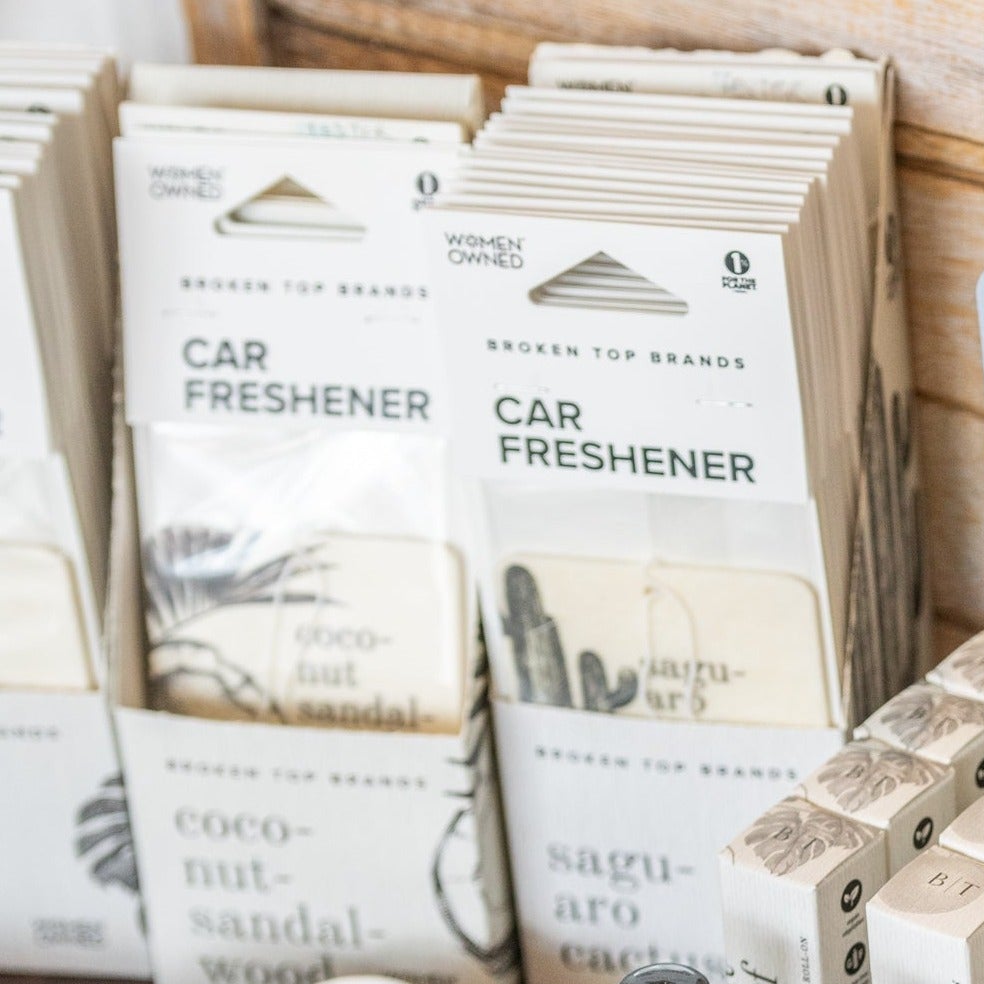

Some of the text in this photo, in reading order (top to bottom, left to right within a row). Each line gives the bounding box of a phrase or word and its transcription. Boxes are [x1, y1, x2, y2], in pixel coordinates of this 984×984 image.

[444, 231, 523, 252] WOMEN
[448, 249, 523, 270] OWNED
[181, 276, 429, 299] BROKEN TOP BRANDS
[182, 338, 269, 371] CAR
[487, 338, 746, 370] BROKEN TOP BRANDS
[184, 379, 430, 421] FRESHENER
[494, 396, 582, 430] CAR
[499, 435, 756, 484] FRESHENER
[272, 766, 316, 784] TOP
[329, 772, 428, 790] BRANDS
[535, 745, 798, 782] BROKEN TOP BRANDS
[174, 804, 313, 848] coco-
[183, 853, 293, 892] nut-
[547, 840, 695, 886] sagu-
[190, 902, 386, 950] sandal-
[554, 893, 640, 929] aro
